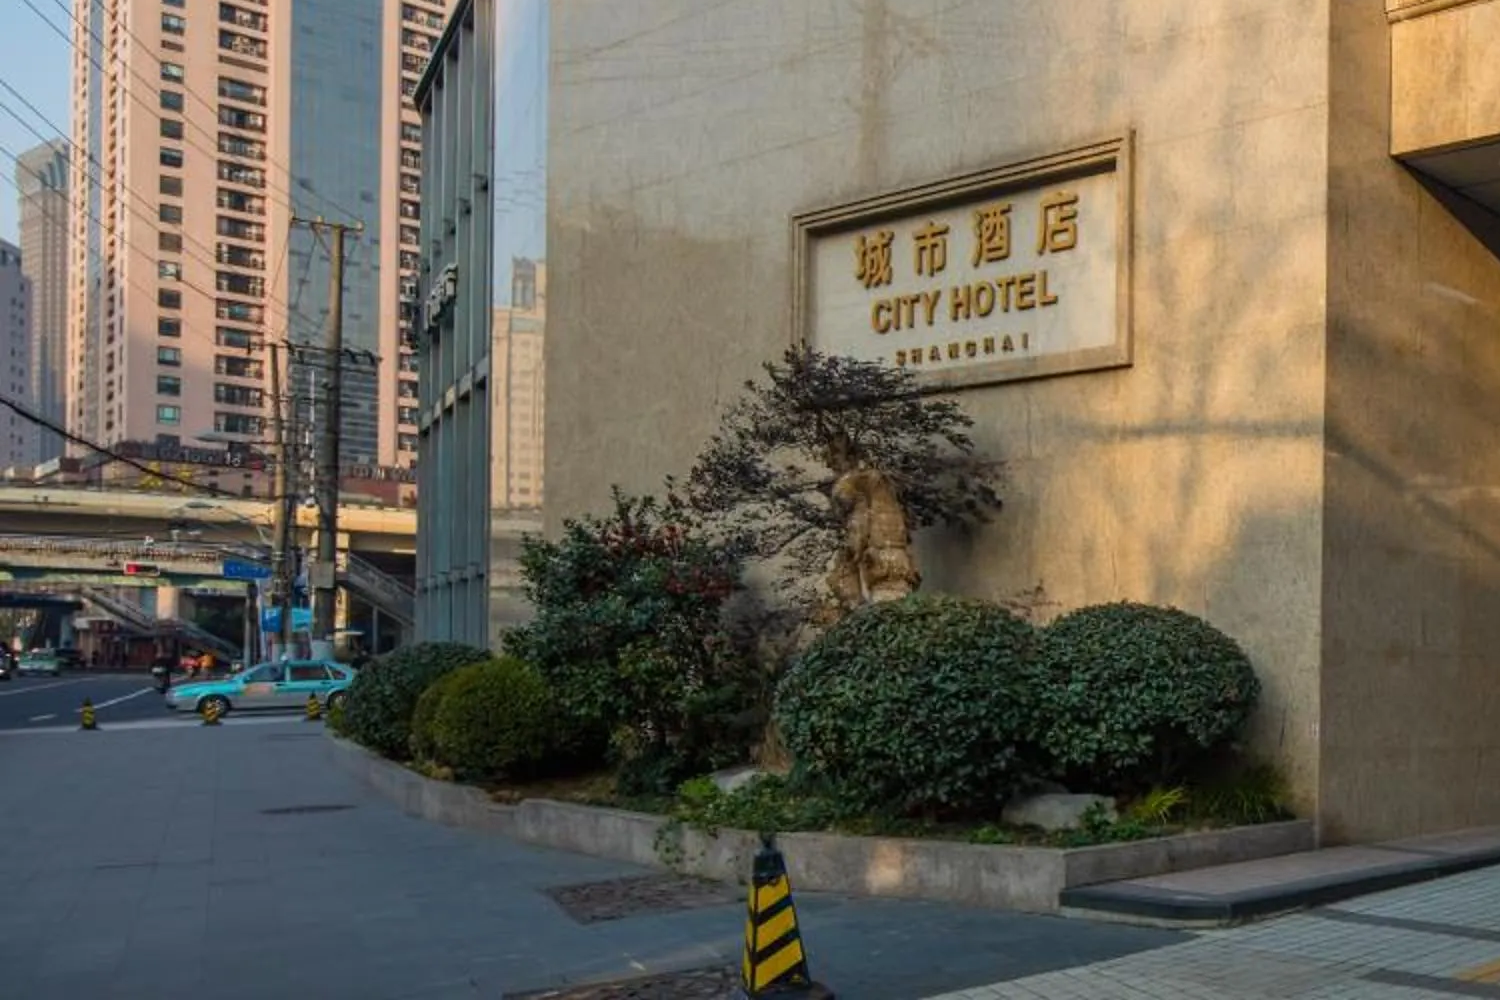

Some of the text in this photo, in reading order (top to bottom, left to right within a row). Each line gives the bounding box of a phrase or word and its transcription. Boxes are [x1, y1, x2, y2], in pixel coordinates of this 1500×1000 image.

[854, 191, 1079, 289] 城市酒店
[871, 270, 1058, 334] CITY HOTEL
[896, 332, 1028, 366] SHANGHAI
